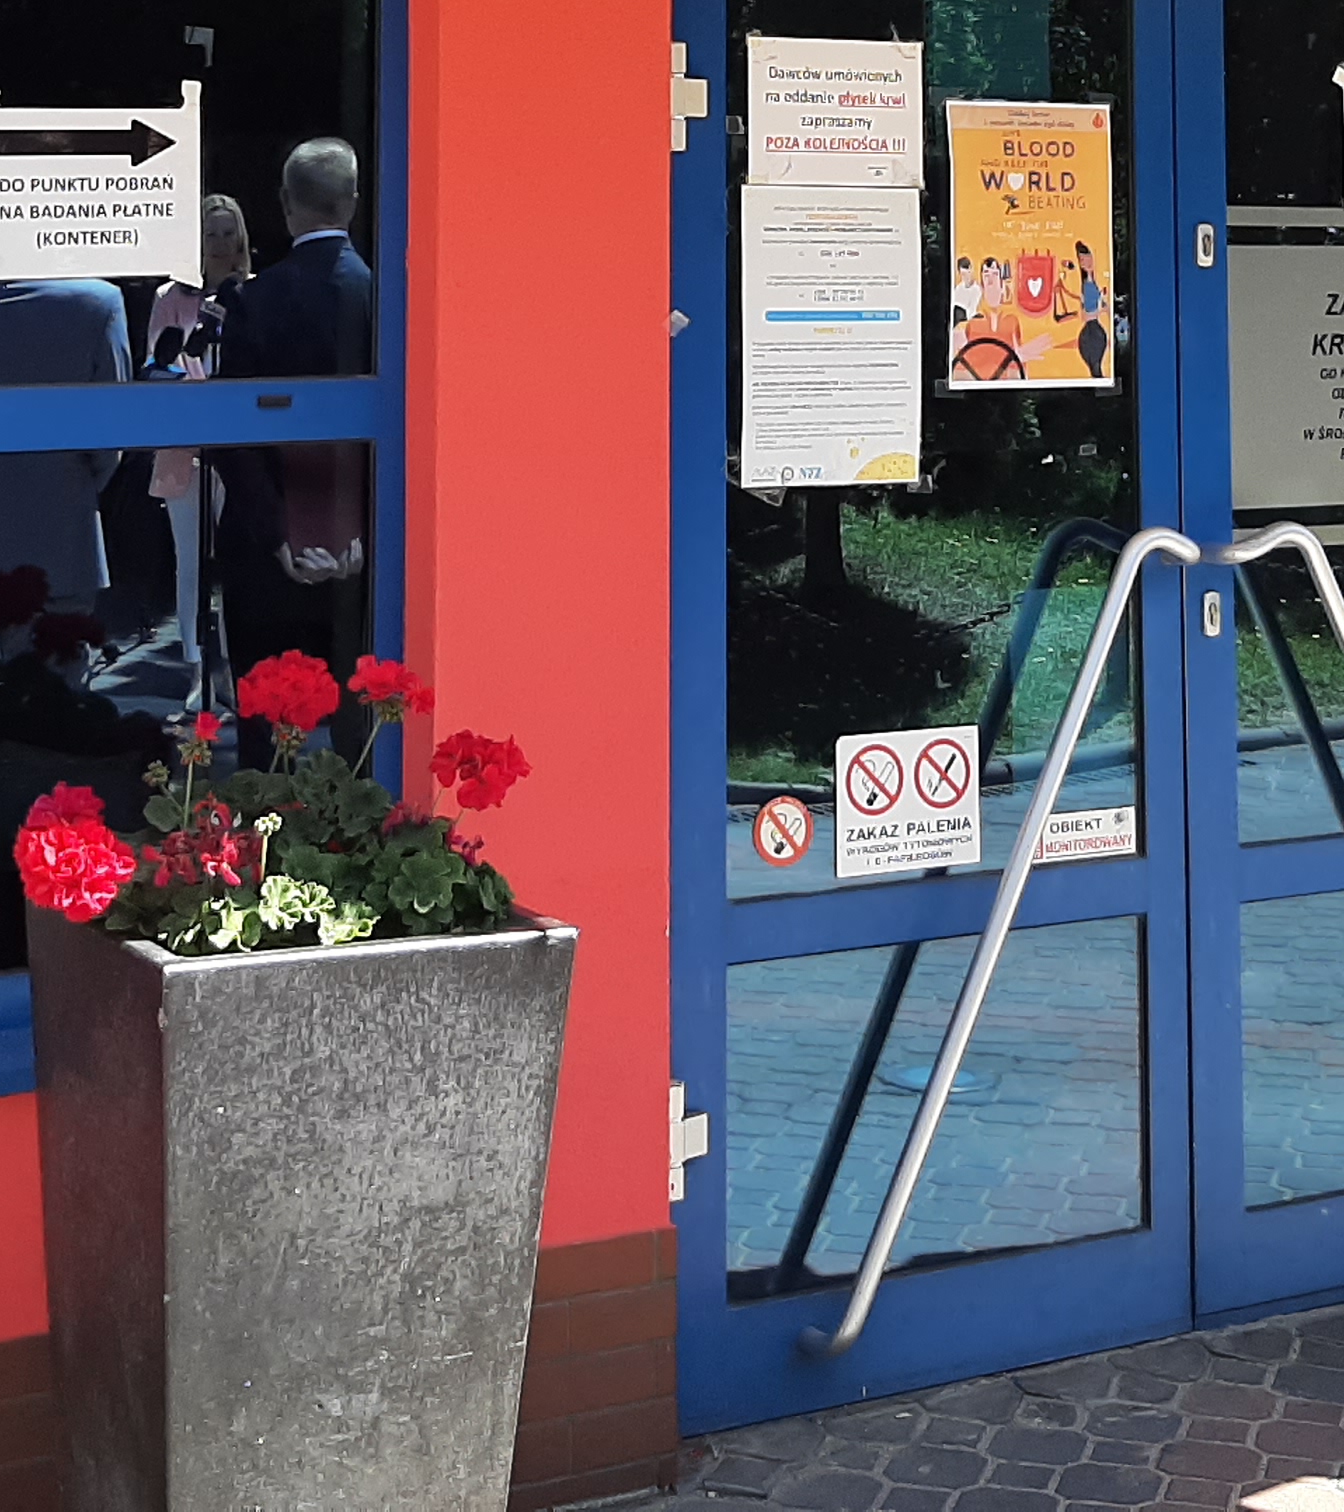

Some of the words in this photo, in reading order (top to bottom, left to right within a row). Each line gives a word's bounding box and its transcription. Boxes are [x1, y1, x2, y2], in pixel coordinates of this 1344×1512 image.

[765, 92, 780, 103] na
[784, 89, 834, 103] oddanie
[800, 116, 872, 130] zapraszamy
[766, 136, 800, 149] POZA
[1004, 140, 1075, 157] BLOOD
[0, 178, 25, 192] DO
[31, 177, 99, 192] PUNKTU
[106, 173, 173, 191] POBRAŃ
[1028, 195, 1086, 209] BEATING
[0, 205, 24, 219] NA
[30, 204, 107, 219] BADANIA
[113, 202, 173, 217] PŁATNE
[36, 229, 138, 249] (KONTENER)
[1303, 428, 1314, 440] W
[846, 824, 899, 842] ZAKAZ
[907, 817, 972, 835] PALENIA
[1049, 818, 1103, 834] OBIEKT
